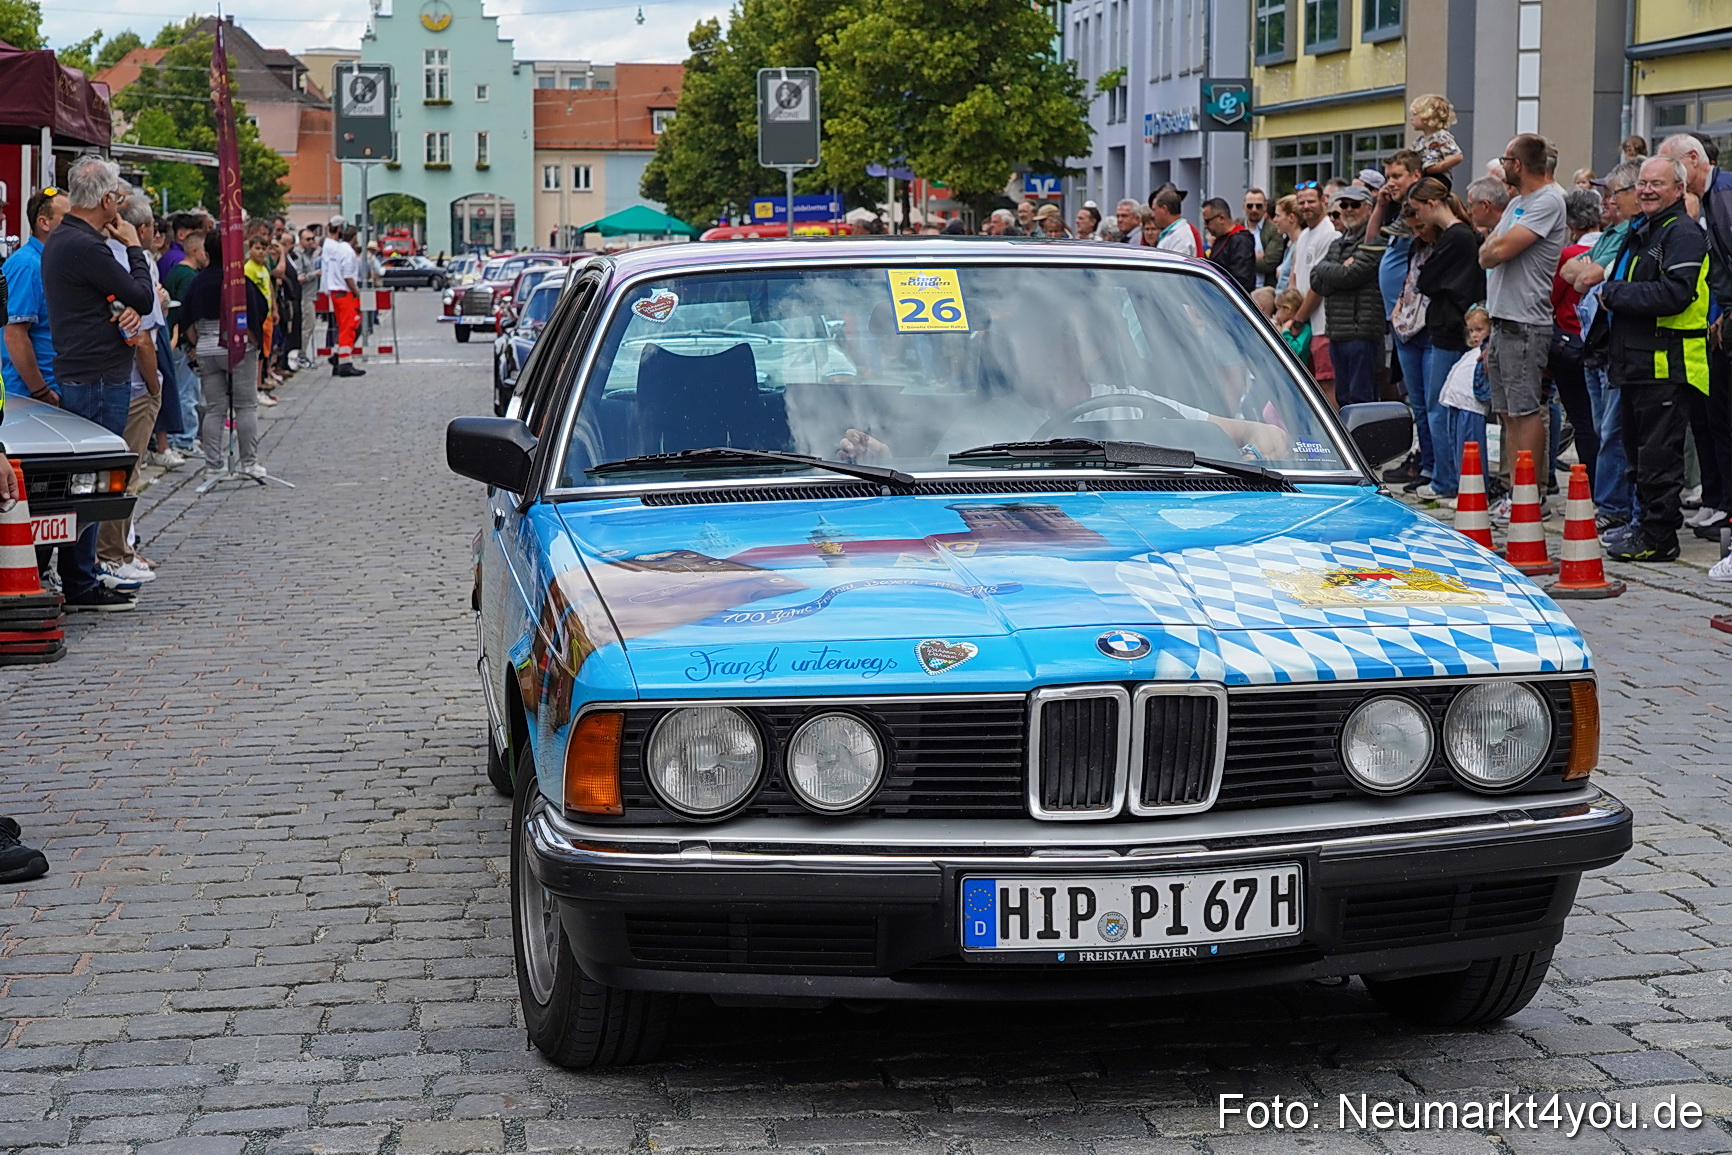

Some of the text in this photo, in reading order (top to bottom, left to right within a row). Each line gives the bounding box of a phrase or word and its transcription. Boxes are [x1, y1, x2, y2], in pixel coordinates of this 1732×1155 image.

[898, 297, 962, 323] 26
[721, 612, 766, 624] 100
[766, 605, 813, 625] Jahre
[863, 579, 920, 588] Bayern
[684, 644, 899, 684] Franzl unterwegs
[974, 920, 987, 936] D
[999, 886, 1097, 940] HIP
[1131, 883, 1189, 938] PI
[1078, 946, 1199, 962] FREISTAAT BAYERN
